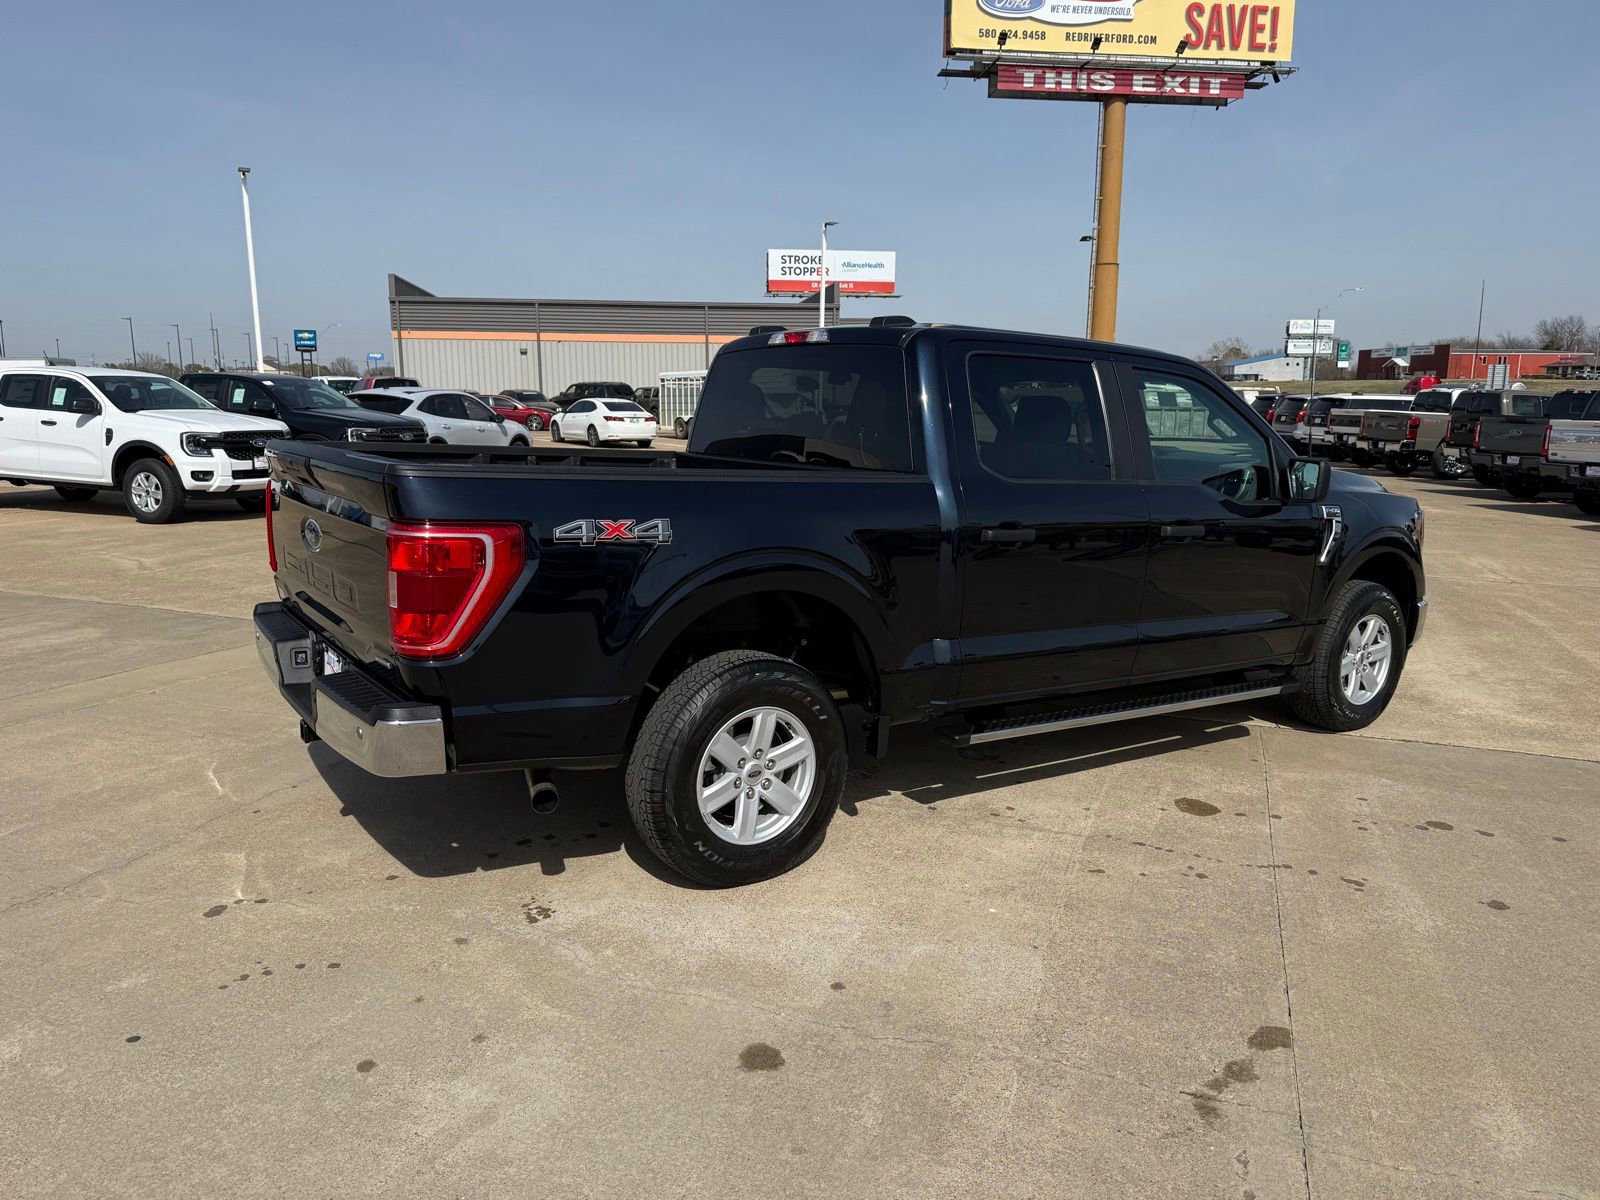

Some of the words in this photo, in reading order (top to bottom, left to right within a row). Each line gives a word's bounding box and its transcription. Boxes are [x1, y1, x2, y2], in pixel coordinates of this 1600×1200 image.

[1050, 4, 1071, 14] WE'RE
[1072, 5, 1093, 15] NEVER
[1094, 6, 1133, 17] UNDERSOLD.
[978, 28, 1046, 40] 58024.9458
[1184, 2, 1280, 52] SAVE!
[1015, 69, 1116, 92] THIS
[1132, 74, 1229, 95] EXIT
